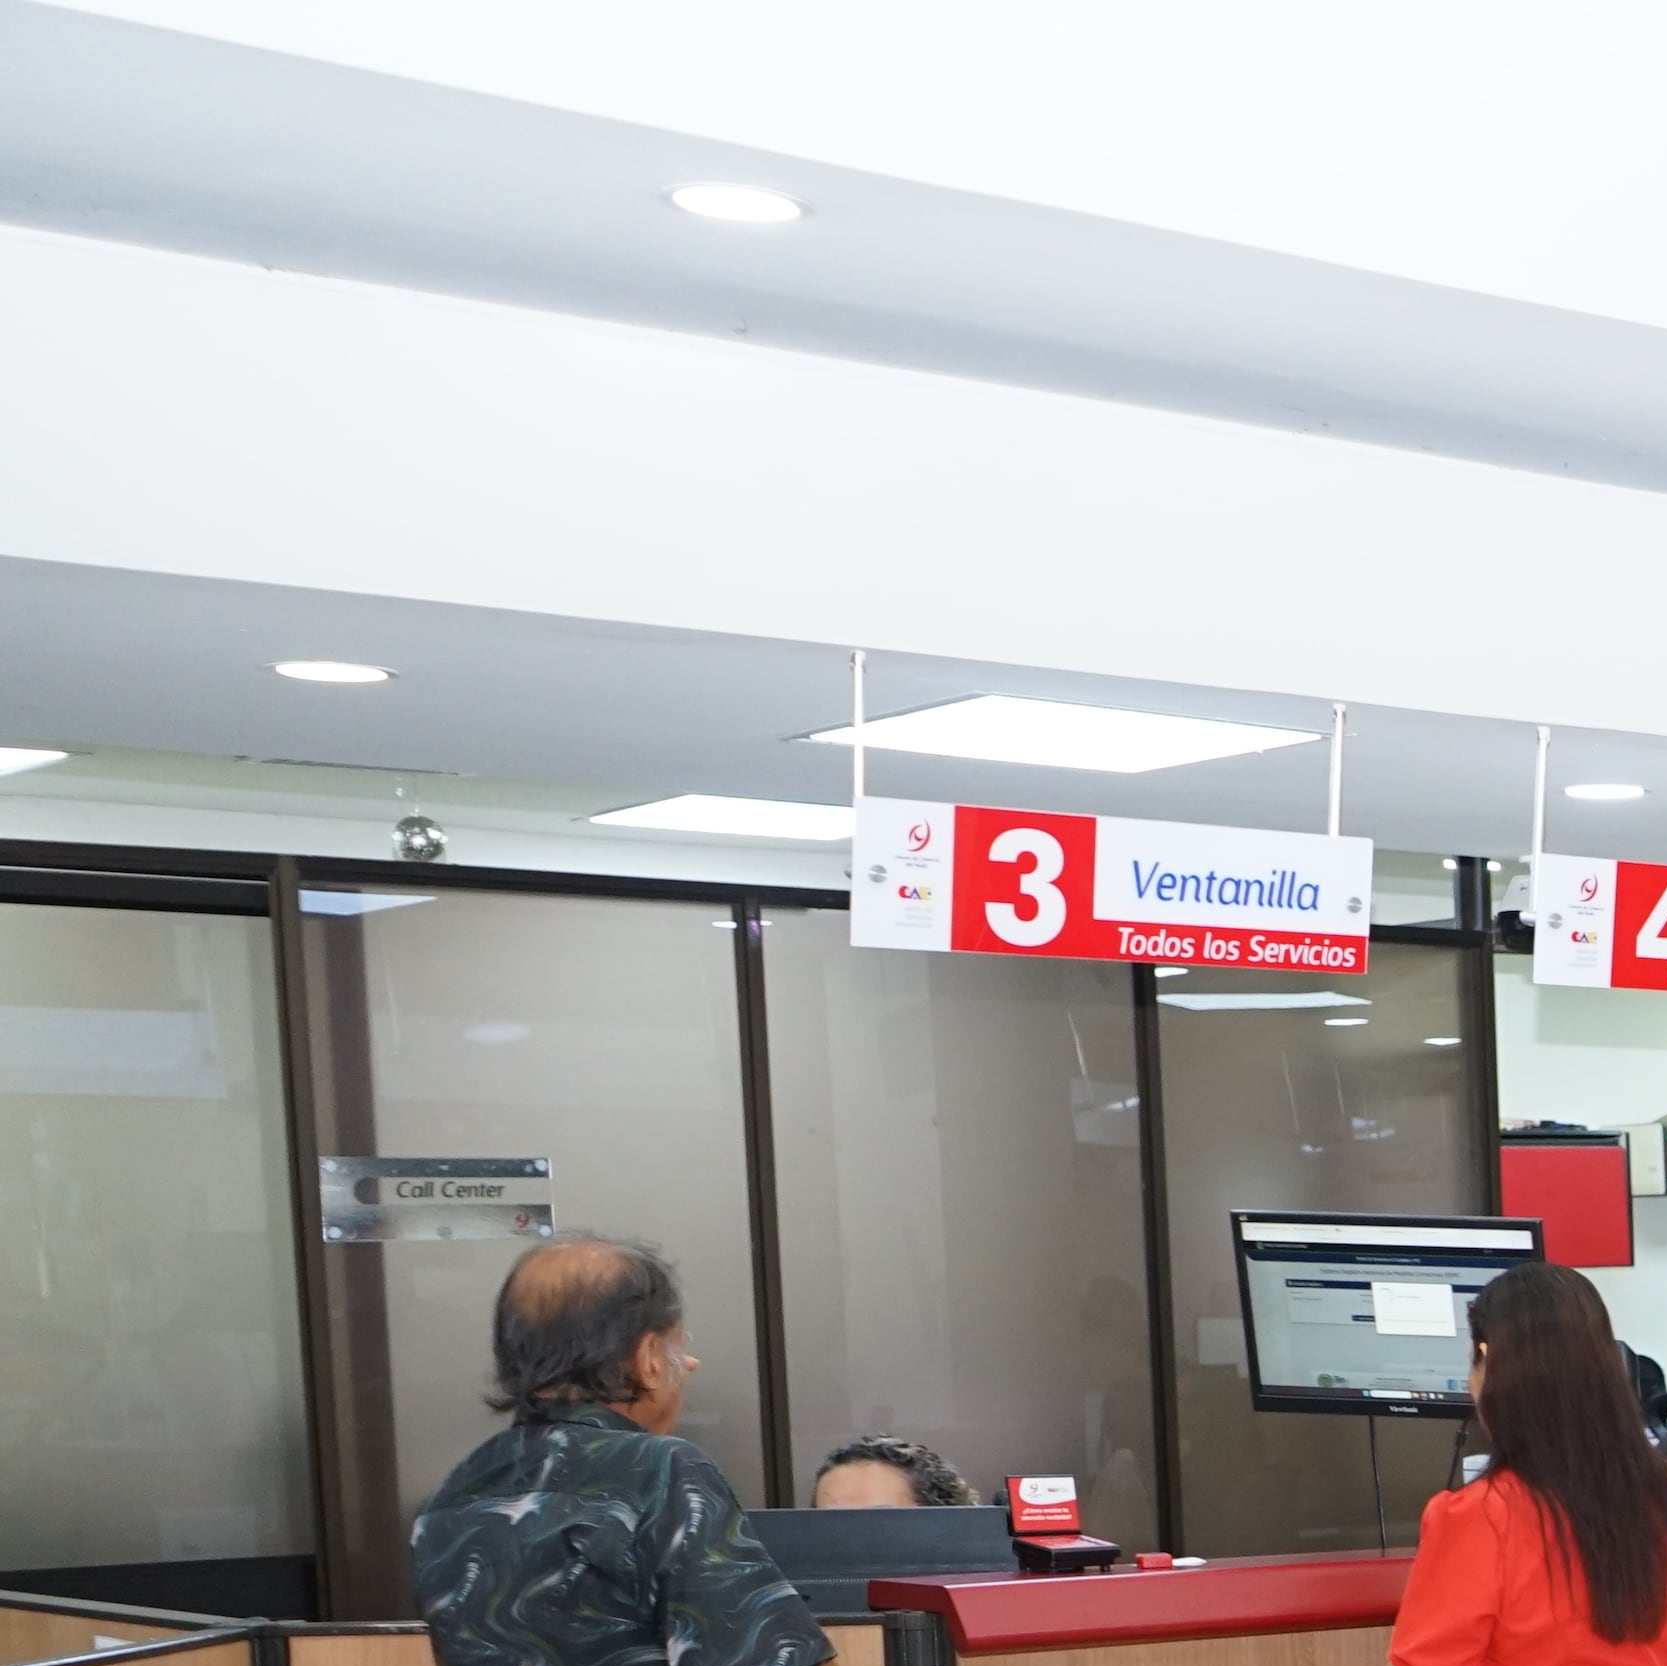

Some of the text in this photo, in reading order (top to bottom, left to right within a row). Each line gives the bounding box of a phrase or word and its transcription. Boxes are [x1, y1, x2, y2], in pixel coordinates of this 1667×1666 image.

[984, 827, 1067, 947] 3
[1132, 859, 1320, 912] Ventanilla
[1117, 926, 1357, 968] Todos los Servicios
[396, 1180, 506, 1198] Call Center
